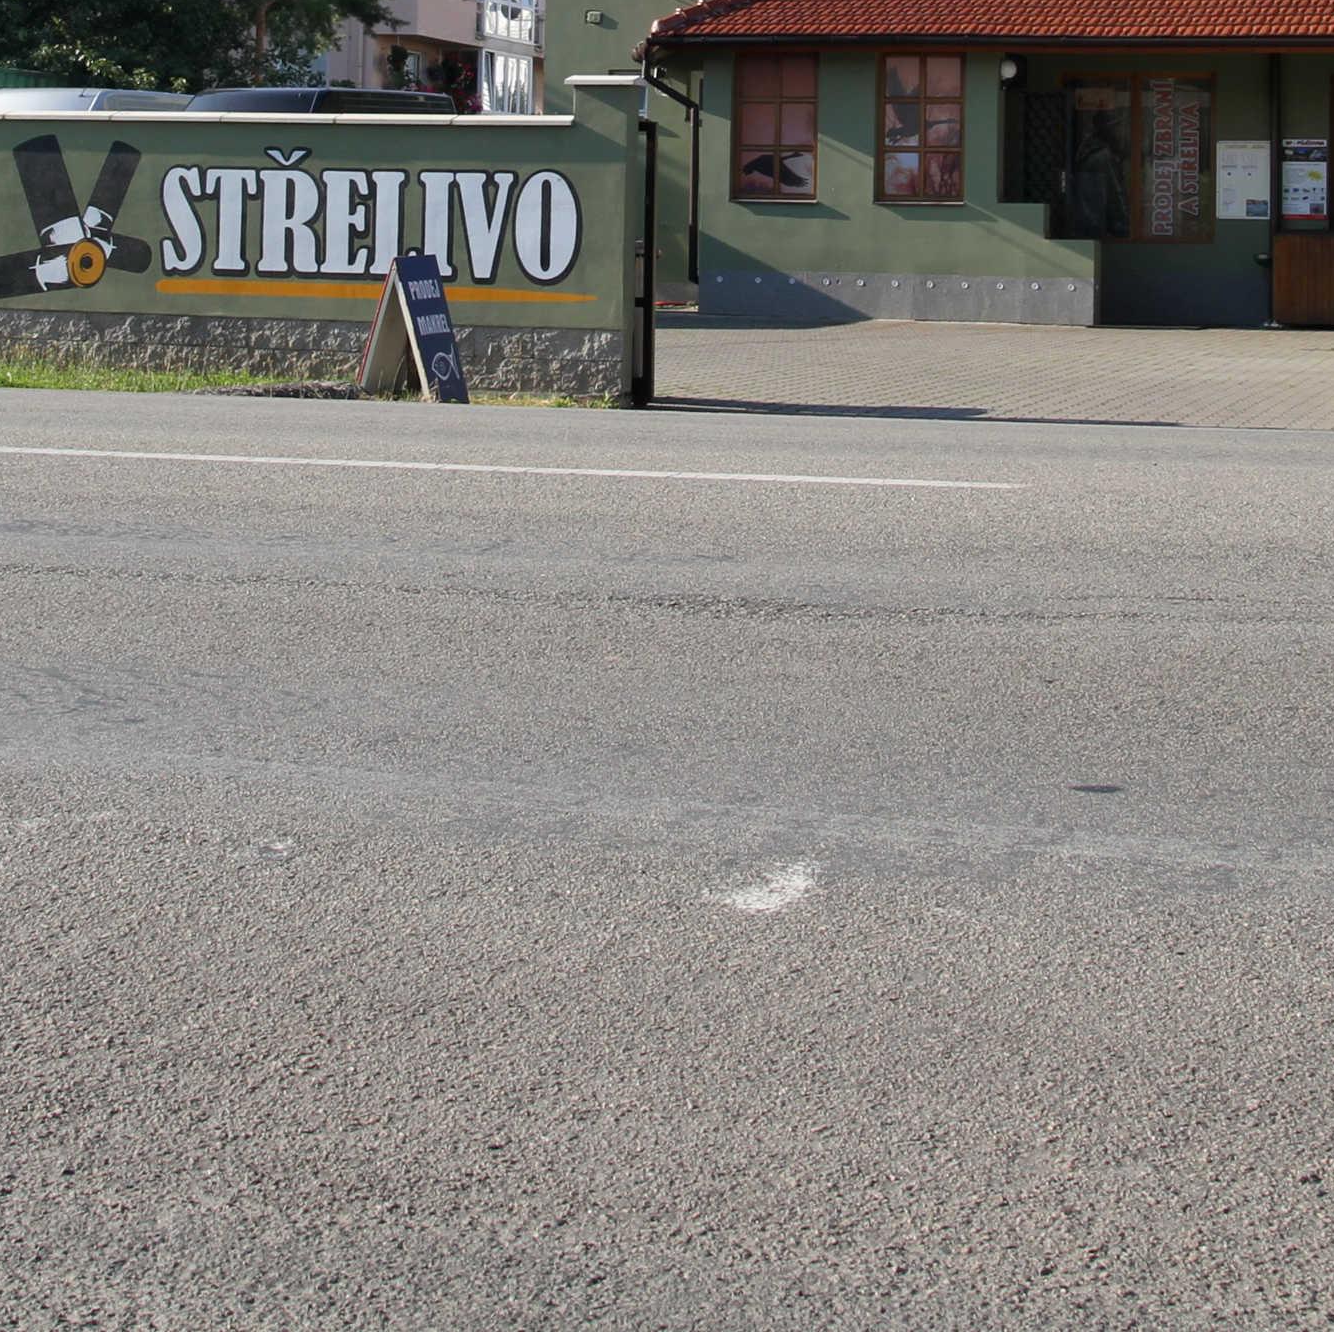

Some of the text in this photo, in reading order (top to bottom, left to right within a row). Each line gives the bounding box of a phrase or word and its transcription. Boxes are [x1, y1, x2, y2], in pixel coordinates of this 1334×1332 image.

[161, 148, 580, 282] STŘELIVO
[1150, 79, 1181, 236] PRODEJ ZBRANÍ
[1173, 100, 1200, 216] A STŘELIVA
[407, 279, 440, 300] PRODEJ
